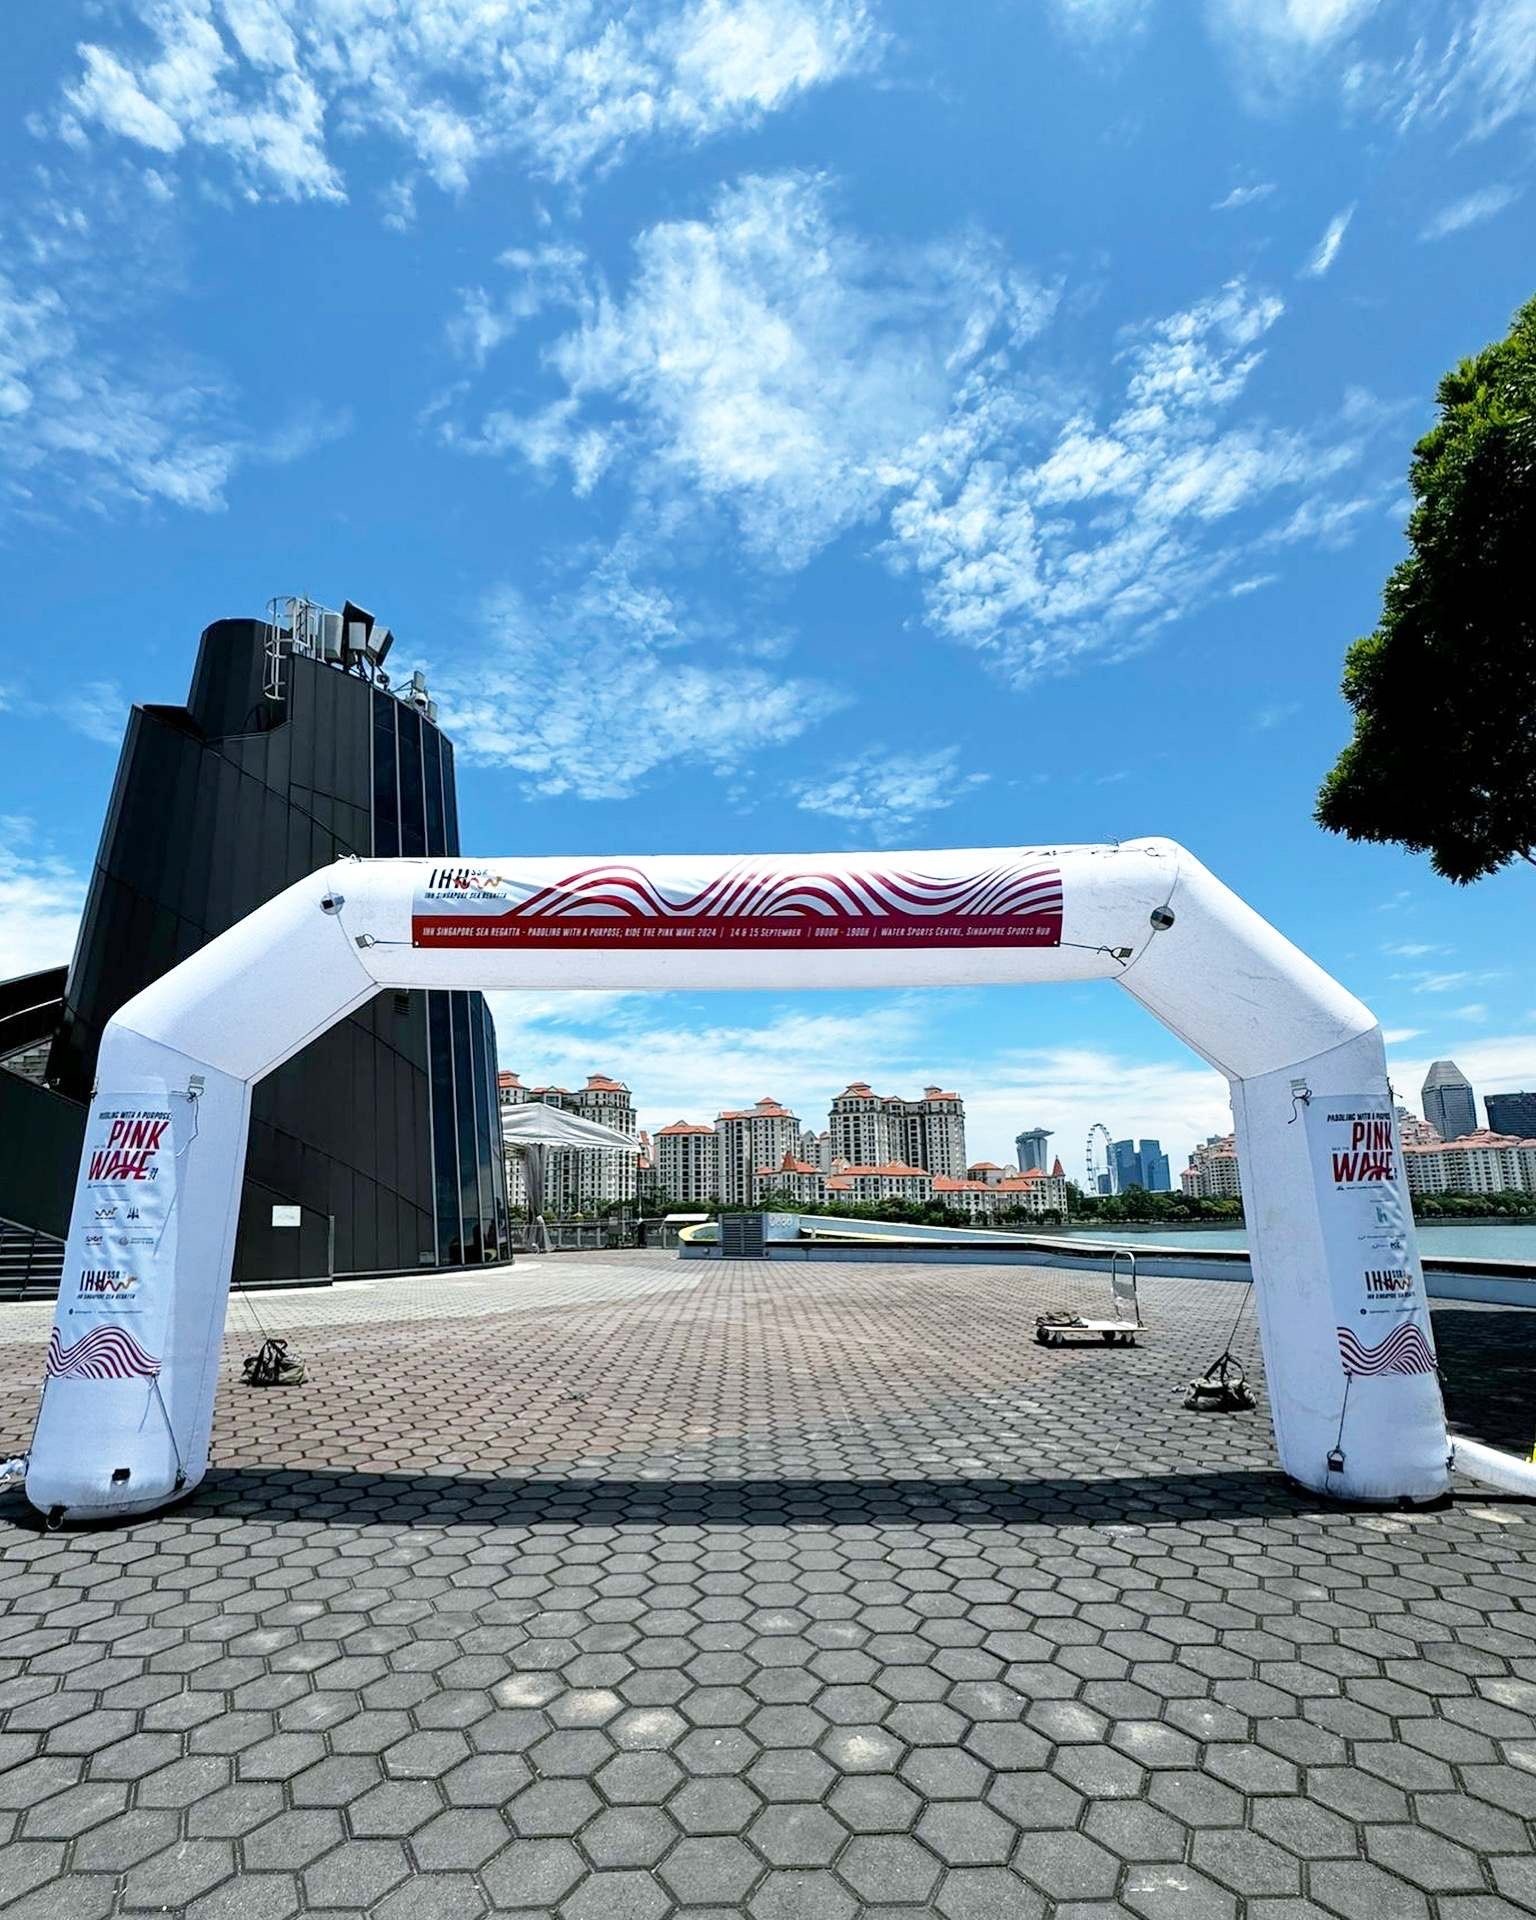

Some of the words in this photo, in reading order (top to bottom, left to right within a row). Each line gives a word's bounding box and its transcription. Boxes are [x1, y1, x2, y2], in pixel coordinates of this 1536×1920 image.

[422, 927, 434, 936] IHH
[436, 927, 474, 936] SINGAPORE
[475, 927, 489, 936] SEA
[490, 927, 520, 936] REGATTA
[527, 928, 561, 937] PADDLING
[562, 928, 581, 937] WITH
[582, 928, 588, 937] A
[589, 928, 623, 938] PURPOSE;
[625, 928, 641, 937] RIDE
[643, 928, 656, 937] THE
[657, 928, 674, 937] PINK
[676, 928, 696, 937] WAVE
[697, 928, 716, 937] 2024
[730, 928, 740, 937] 14
[749, 928, 759, 937] 15
[107, 1120, 169, 1149] PINK
[1352, 1121, 1393, 1150] PINK
[88, 1151, 156, 1180] WAVE
[1333, 1151, 1394, 1182] WAVE
